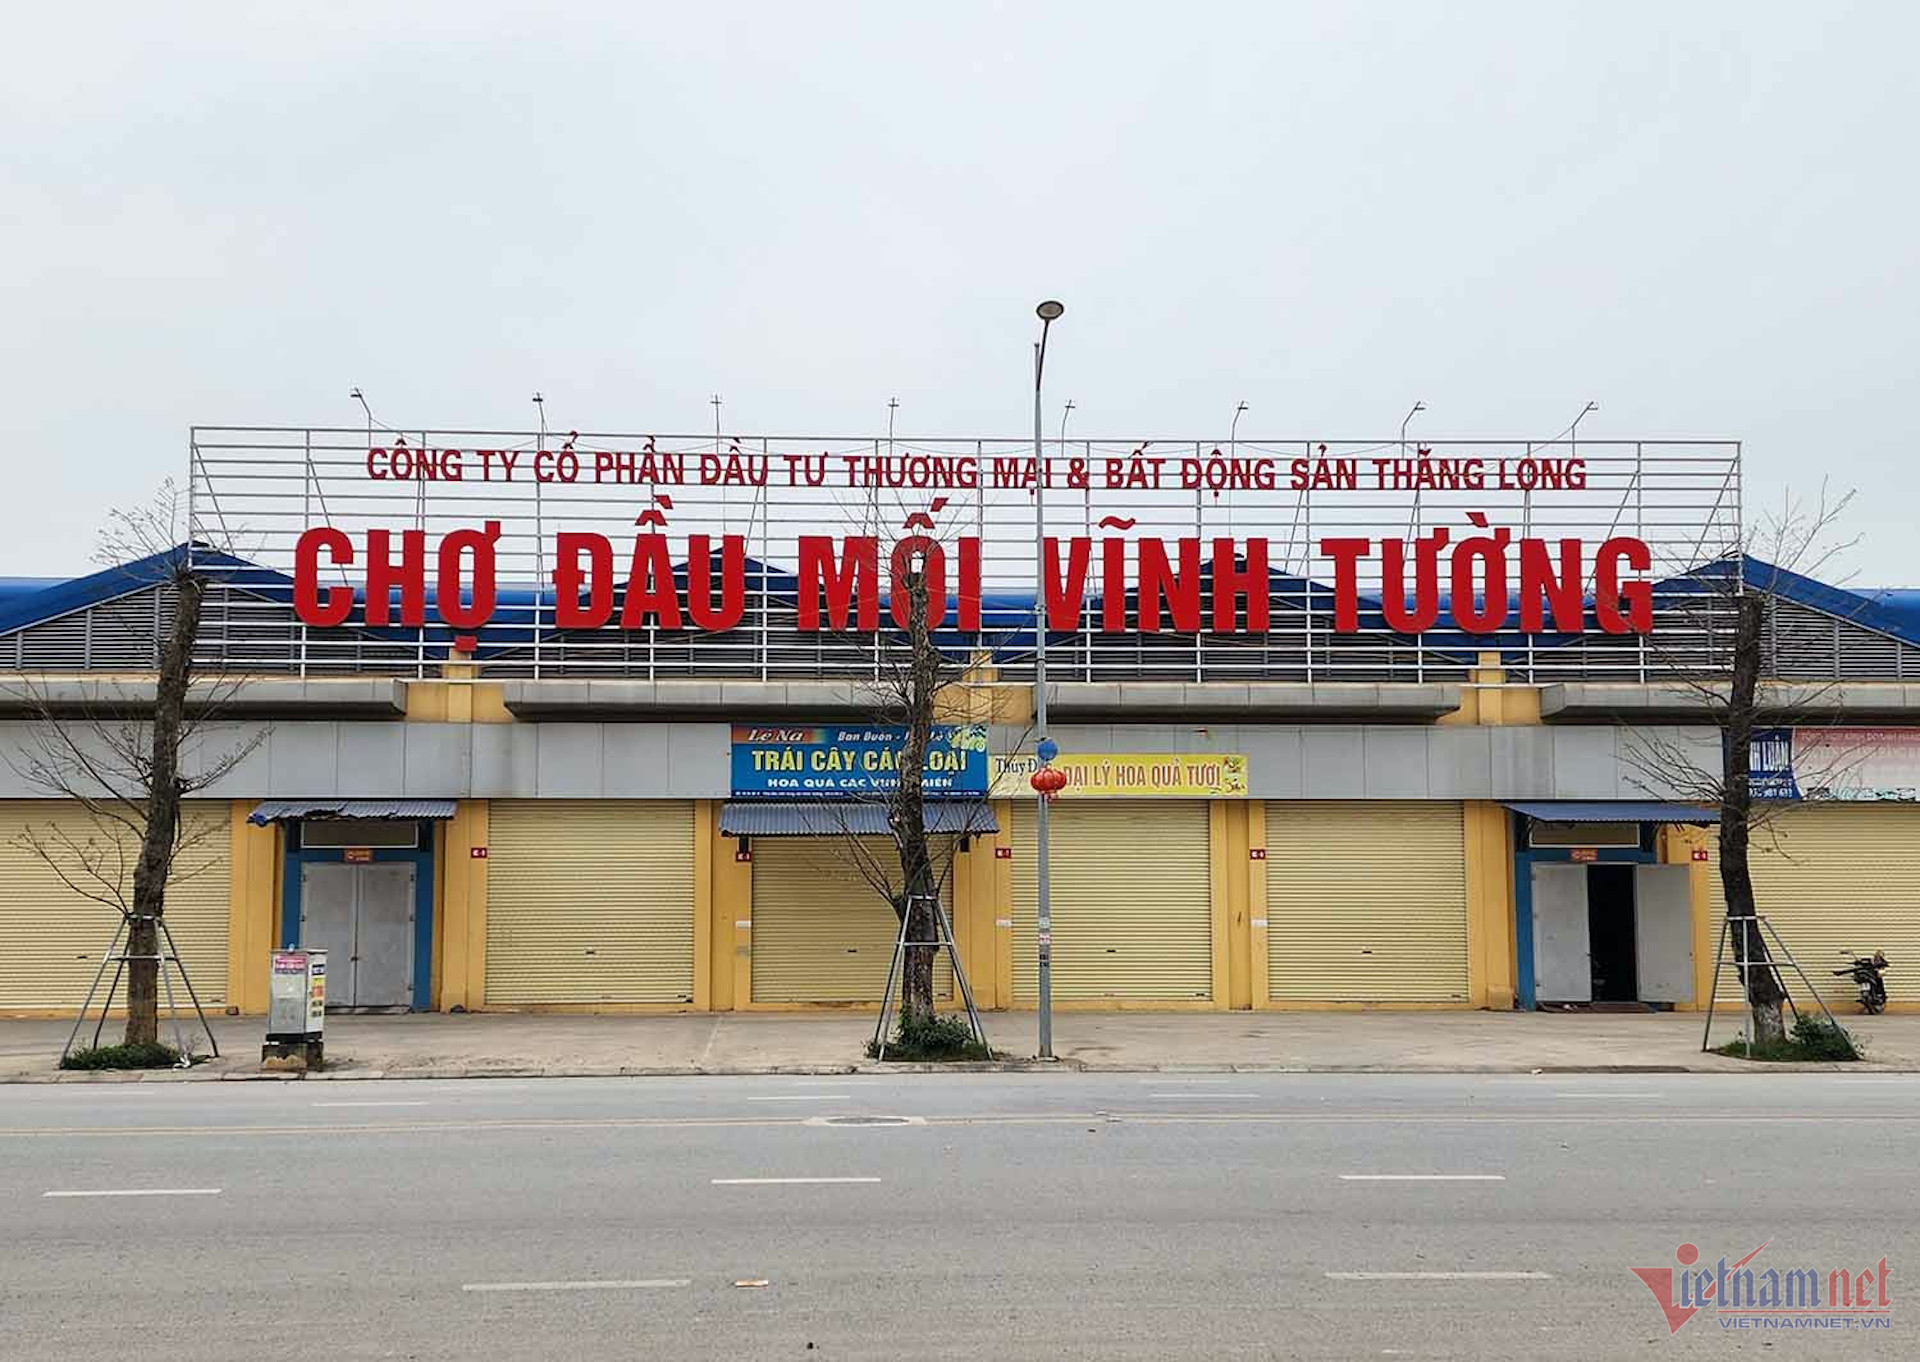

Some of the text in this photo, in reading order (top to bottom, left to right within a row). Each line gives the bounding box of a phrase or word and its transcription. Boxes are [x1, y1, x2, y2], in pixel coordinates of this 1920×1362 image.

[366, 440, 463, 481] CÔNG
[476, 448, 520, 481] TY
[533, 430, 579, 483] CỔ
[698, 438, 768, 486] ĐẦU
[783, 451, 829, 487] TƯ
[843, 452, 978, 489] THƯƠNG
[993, 457, 1052, 495] MẠI
[1067, 456, 1090, 490] &
[1106, 442, 1166, 490] BẤT
[1180, 448, 1275, 499] ĐỘNG
[1291, 443, 1357, 491] SẢN
[1373, 447, 1485, 491] THĂNG
[1499, 458, 1587, 491] LONG
[293, 495, 1654, 654] CHỢ ĐẦU MỐI VĨNH TƯỜNG
[751, 746, 804, 771] TRÁI
[810, 746, 856, 771] CÂY
[1116, 765, 1146, 787] HOA
[1151, 757, 1182, 789] QUẢ
[767, 778, 799, 788] HOA
